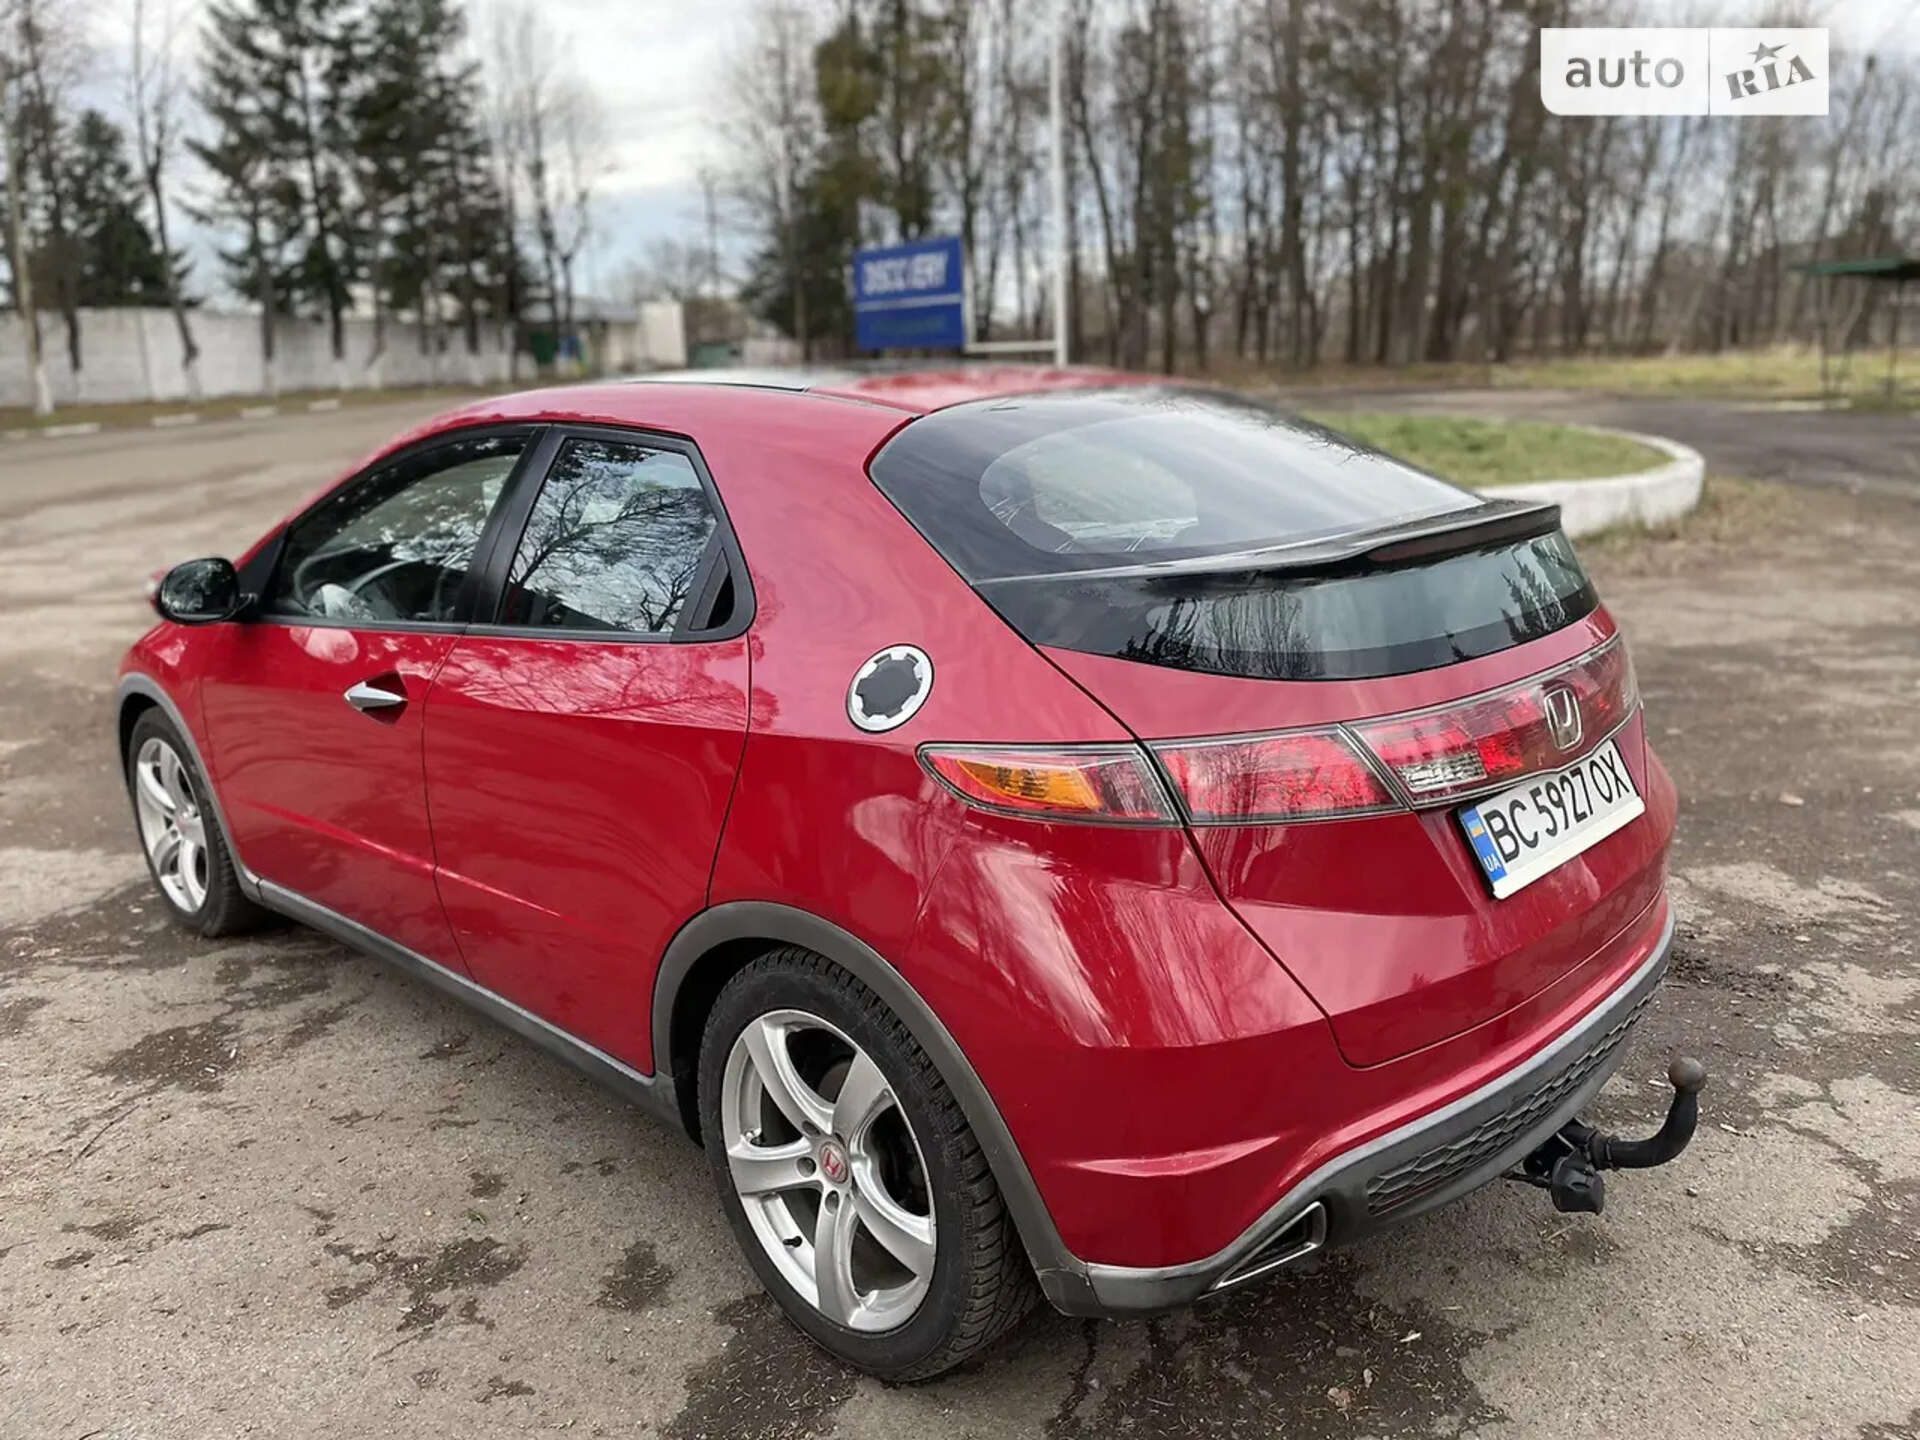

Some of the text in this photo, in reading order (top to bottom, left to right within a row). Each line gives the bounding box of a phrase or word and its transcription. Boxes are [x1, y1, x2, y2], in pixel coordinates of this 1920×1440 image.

[1483, 750, 1630, 863] BC 5927 OX
[1484, 855, 1502, 872] UA
